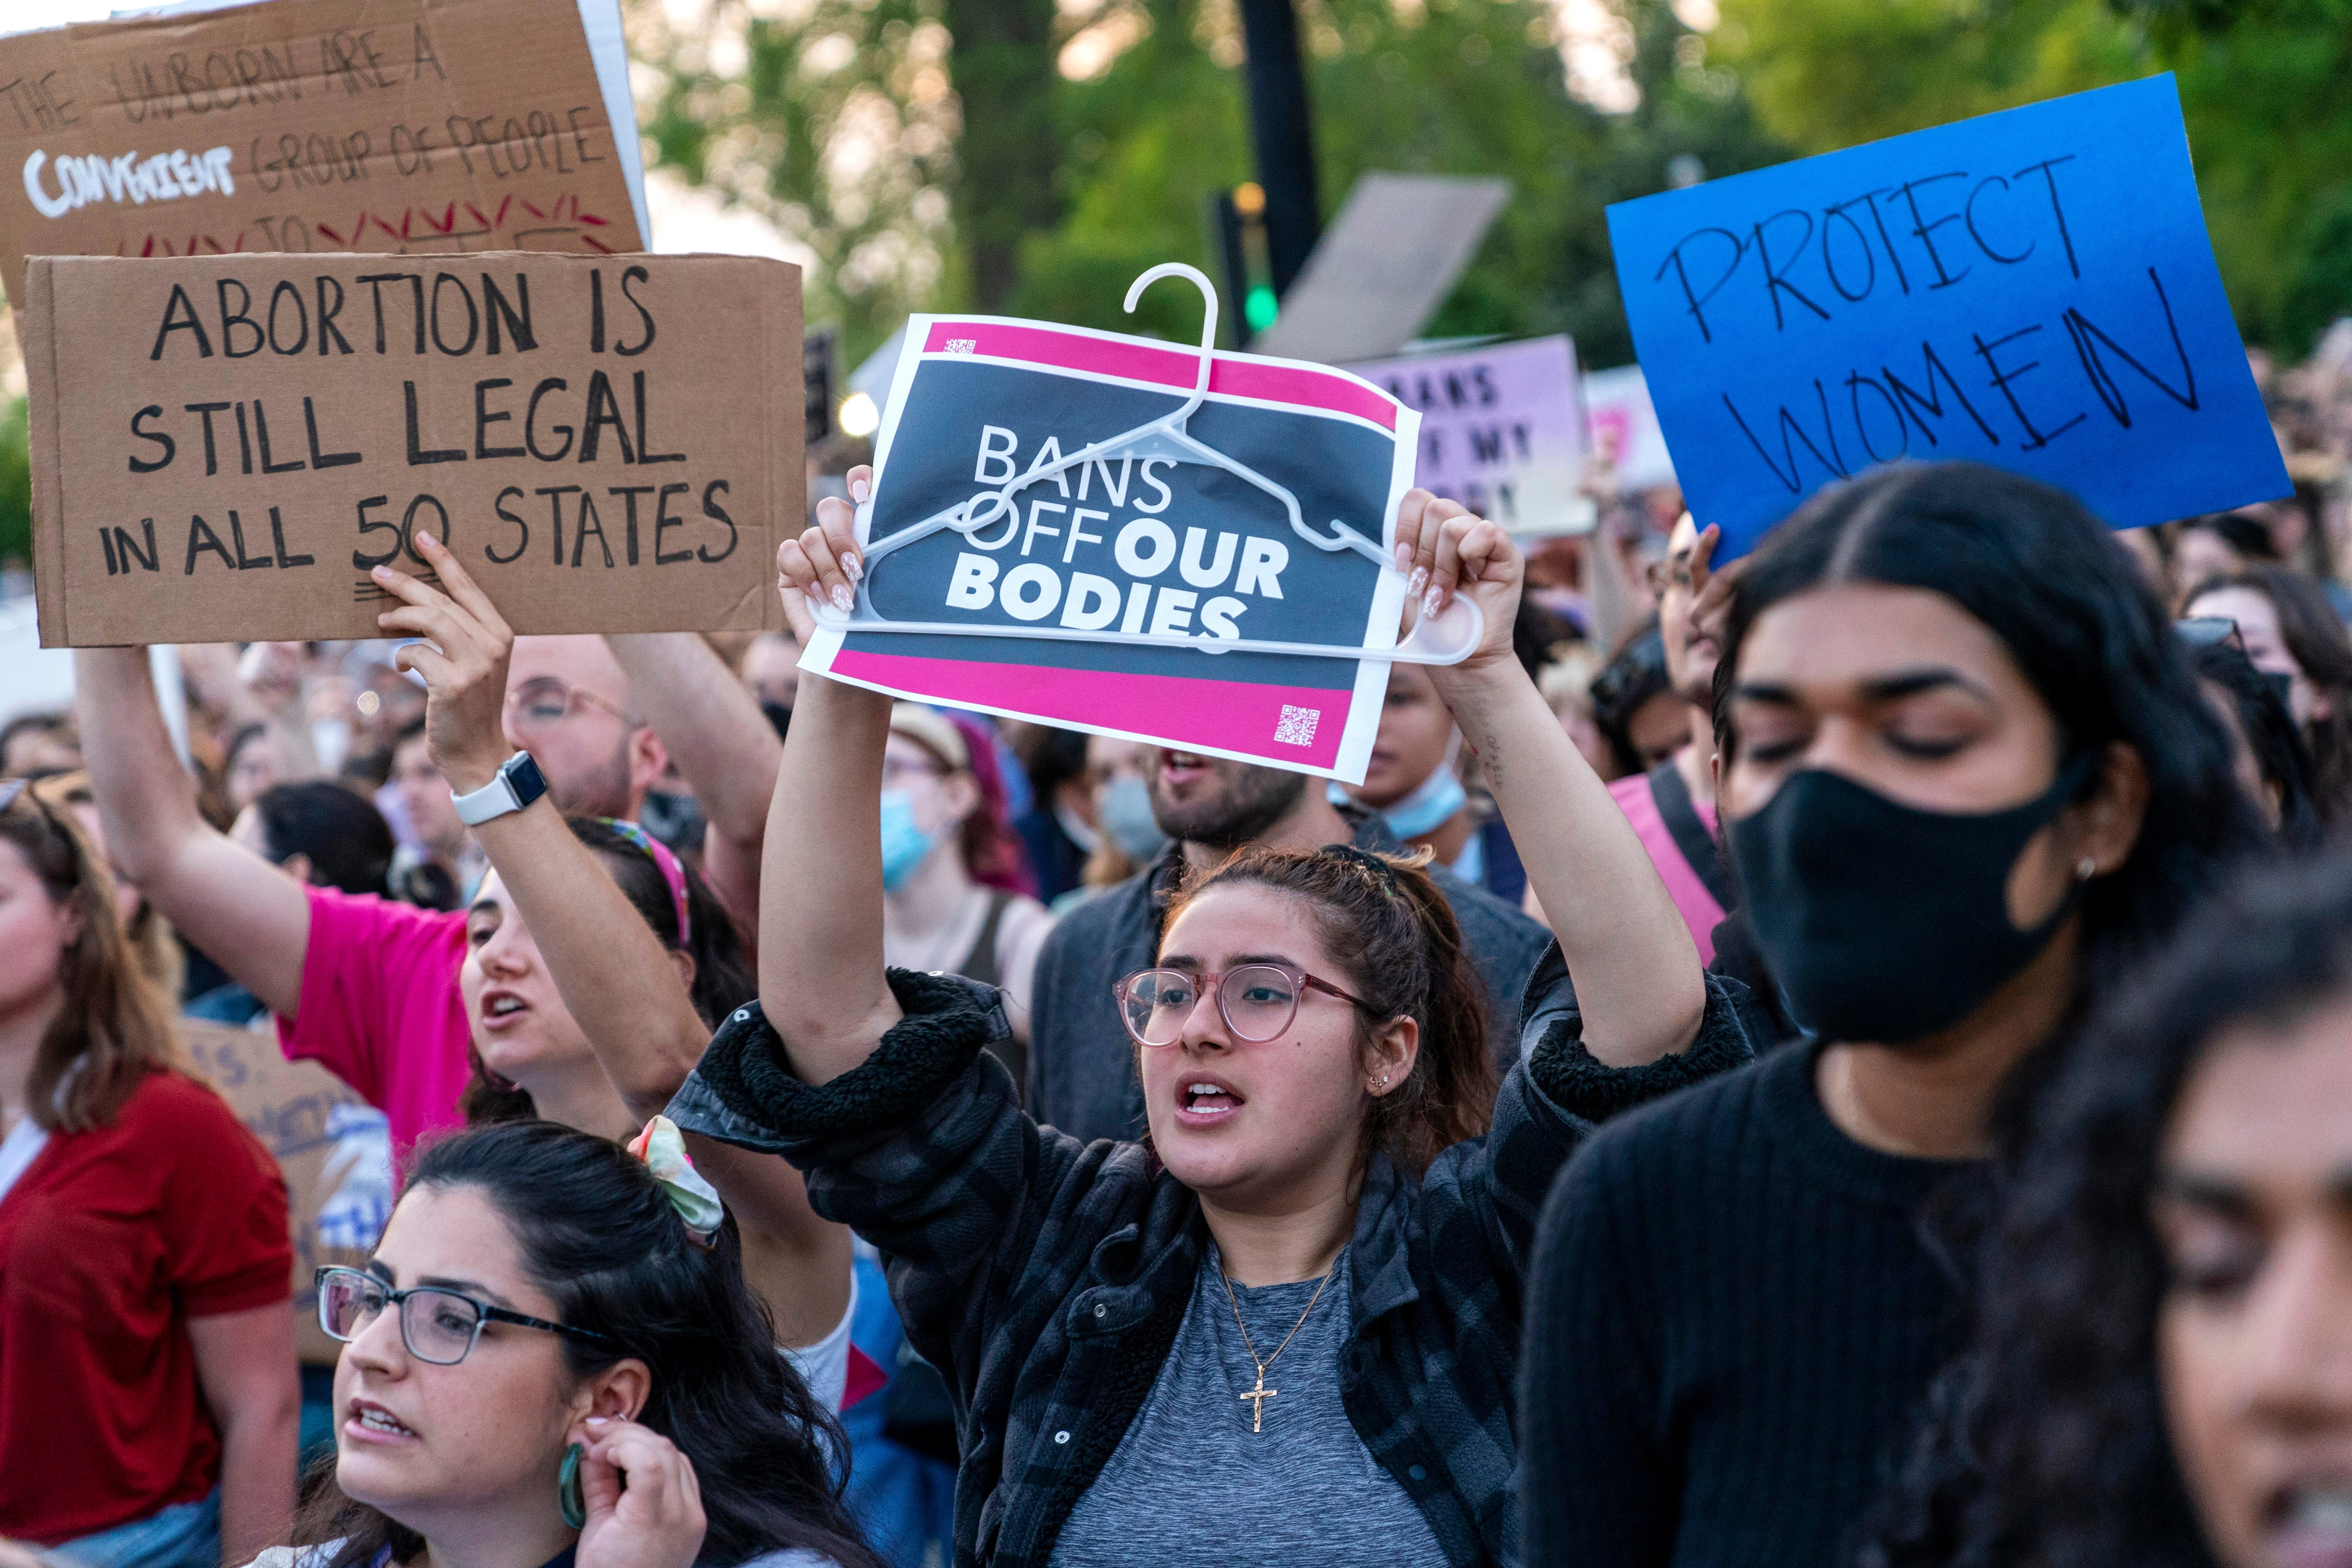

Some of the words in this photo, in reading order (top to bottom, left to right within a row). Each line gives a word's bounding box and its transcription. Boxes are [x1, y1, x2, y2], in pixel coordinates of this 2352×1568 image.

[0, 69, 80, 132] THE
[111, 40, 302, 125] UNBORN
[319, 29, 396, 96] ARE
[413, 23, 447, 82] A
[23, 145, 234, 219] CONVENIENT
[250, 129, 371, 194] GROUP
[391, 123, 436, 177] OF
[445, 105, 606, 179] PEOPLE
[1654, 154, 2079, 344] PROTECT
[150, 270, 538, 361] ABORTION
[589, 265, 657, 358] IS
[128, 395, 363, 477] STILL
[403, 368, 687, 466] LEGAL
[1722, 266, 2200, 495] WOMEN
[974, 424, 1178, 514] BANS
[98, 517, 159, 575] IN
[185, 505, 315, 575] ALL
[352, 493, 450, 570] 50
[484, 479, 739, 568] STATES
[961, 490, 1110, 564] OFF
[1114, 517, 1290, 600] OUR
[945, 551, 1248, 655] BODIES
